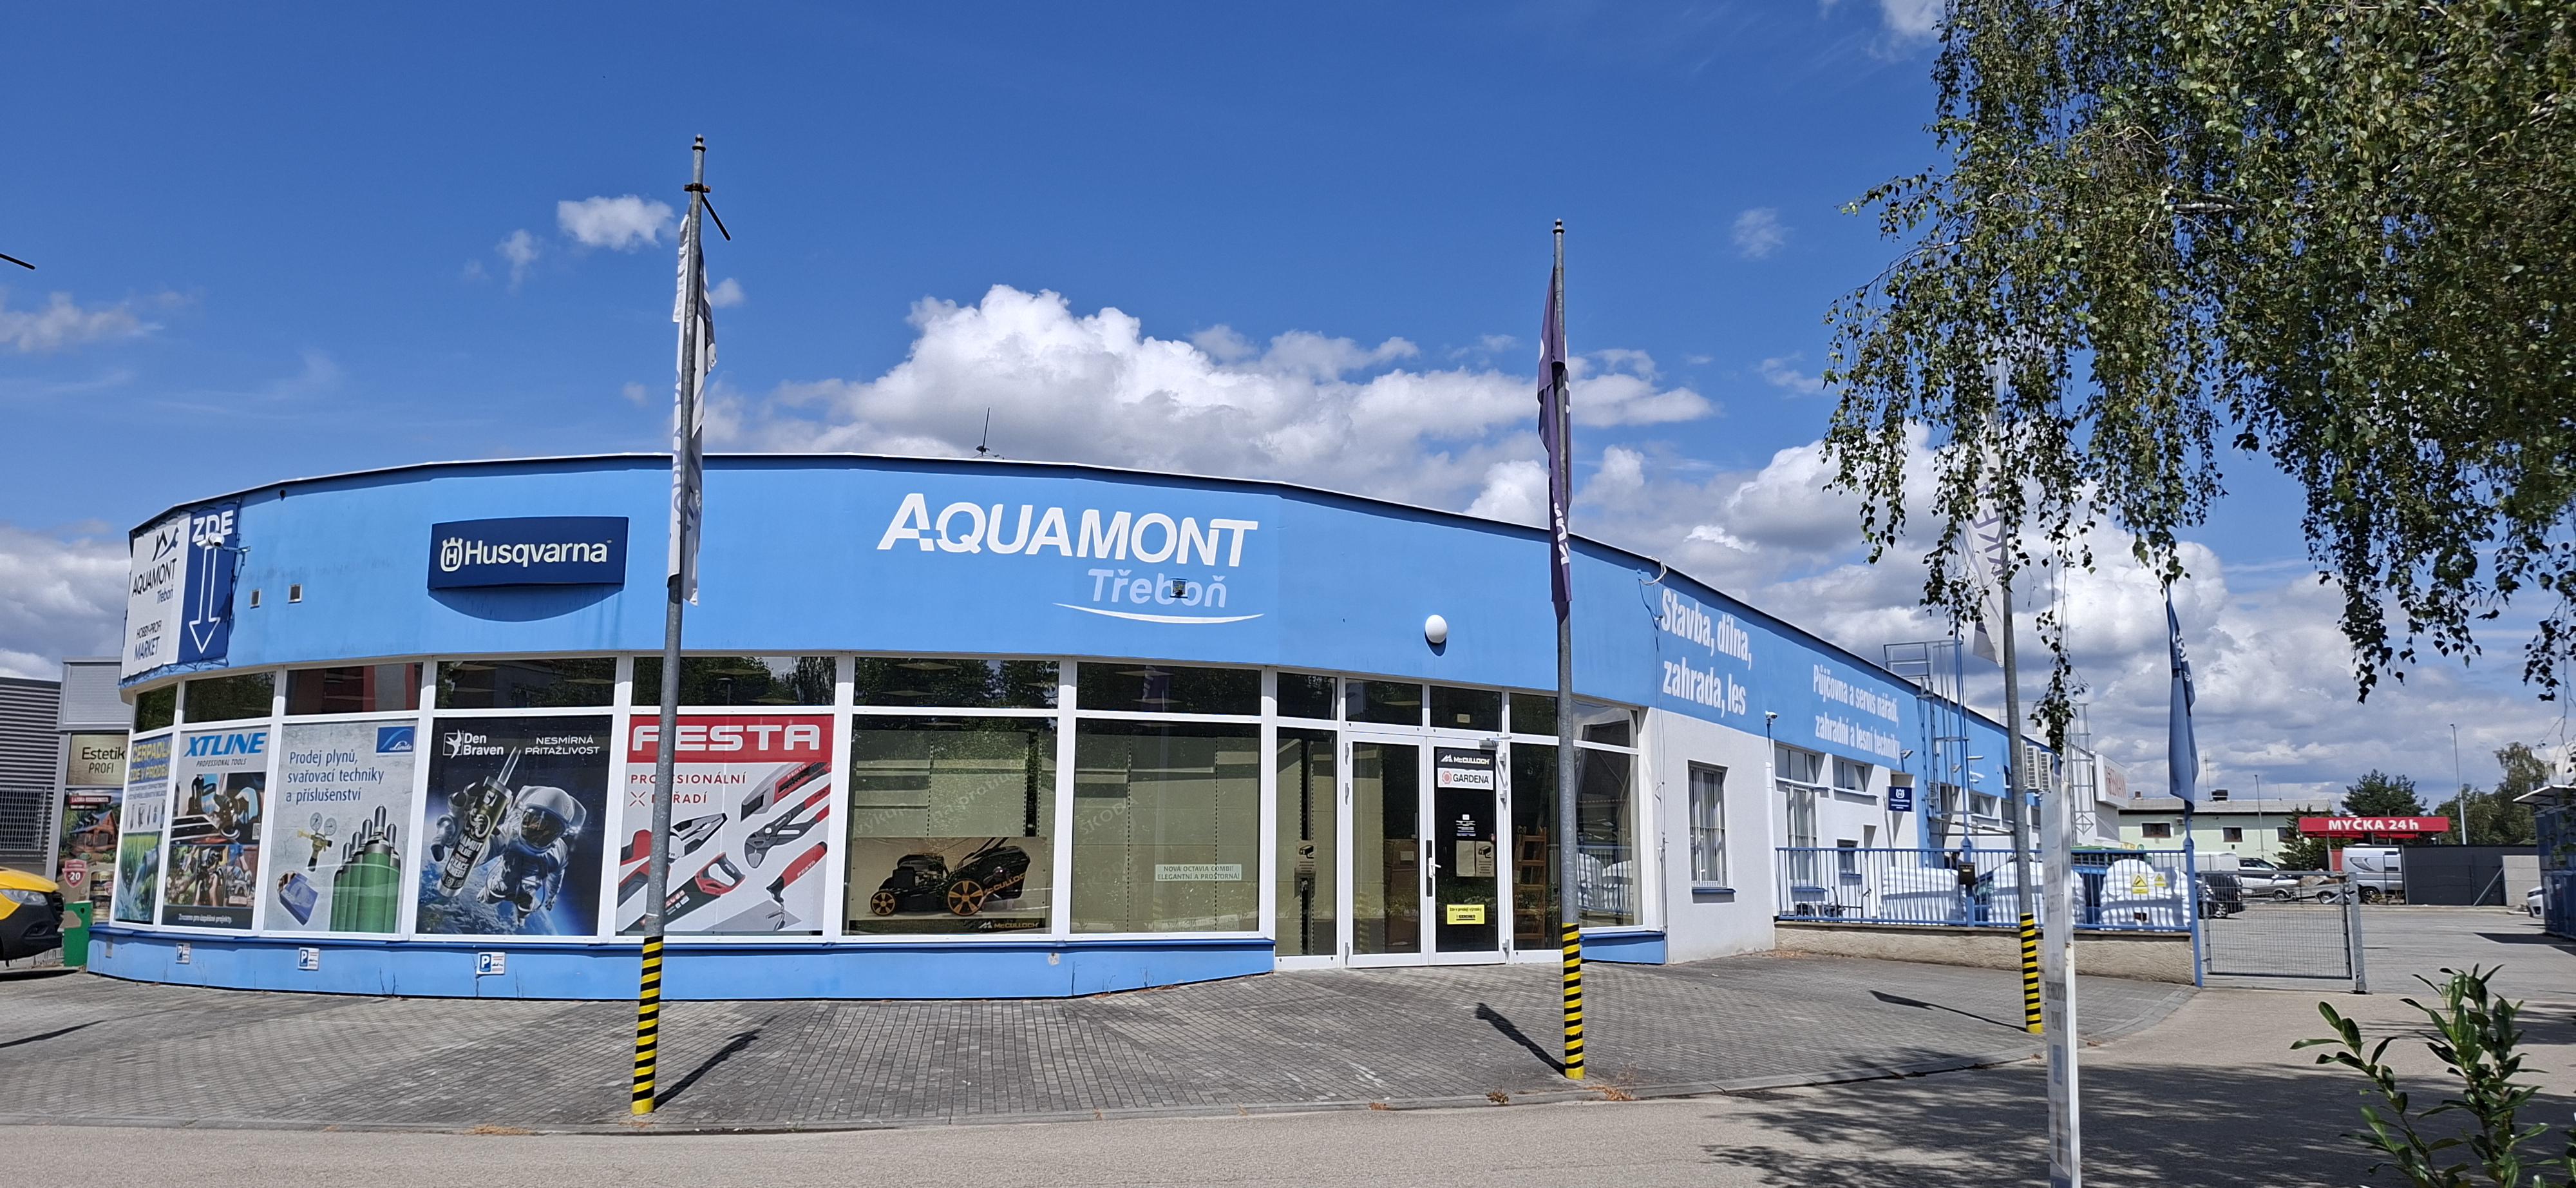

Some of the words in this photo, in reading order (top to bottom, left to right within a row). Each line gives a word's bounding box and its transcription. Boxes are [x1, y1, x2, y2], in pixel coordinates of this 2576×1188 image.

[193, 510, 234, 542] ZDE
[877, 493, 1258, 567] AQUAMONT
[464, 540, 608, 568] Husqvarna
[132, 558, 177, 597] AQUAMONT
[1088, 569, 1227, 608] Třeboň
[1662, 588, 1715, 656] Stavba,
[1717, 614, 1752, 671] dílna,
[134, 637, 160, 661] MARKET
[1663, 657, 1725, 718] zahrada,
[1728, 673, 1746, 716] les
[1814, 664, 1848, 704] Půjčovna
[1850, 685, 1854, 707] a
[1856, 687, 1876, 715] servis
[184, 732, 267, 757] XTLINE
[464, 733, 487, 743] Den
[536, 734, 594, 745] NESMÍRNÁ
[632, 725, 820, 751] FESTA
[1815, 711, 1848, 745] zahradní
[1850, 726, 1855, 747] a
[1856, 722, 1873, 752] lesní
[1874, 729, 1900, 765] techniky
[82, 747, 126, 760] Estetik
[290, 749, 322, 767] Prodej
[325, 749, 357, 767] plynů,
[463, 745, 504, 755] Braven
[525, 745, 600, 755] PŘITAŽLIVOST
[89, 763, 114, 774] PROFI
[196, 759, 229, 767] PROFESSIONAL
[287, 769, 335, 783] svařovací
[339, 767, 384, 785] techniky
[631, 772, 747, 783] PROSIONÁLNÍ
[1453, 774, 1489, 783] GARDENA
[285, 792, 292, 802] a
[296, 787, 361, 805] příslušenství
[651, 790, 707, 804] ŘADÍ
[2328, 818, 2385, 830] MYČKA
[2389, 820, 2407, 830] 24
[2409, 819, 2419, 830] h
